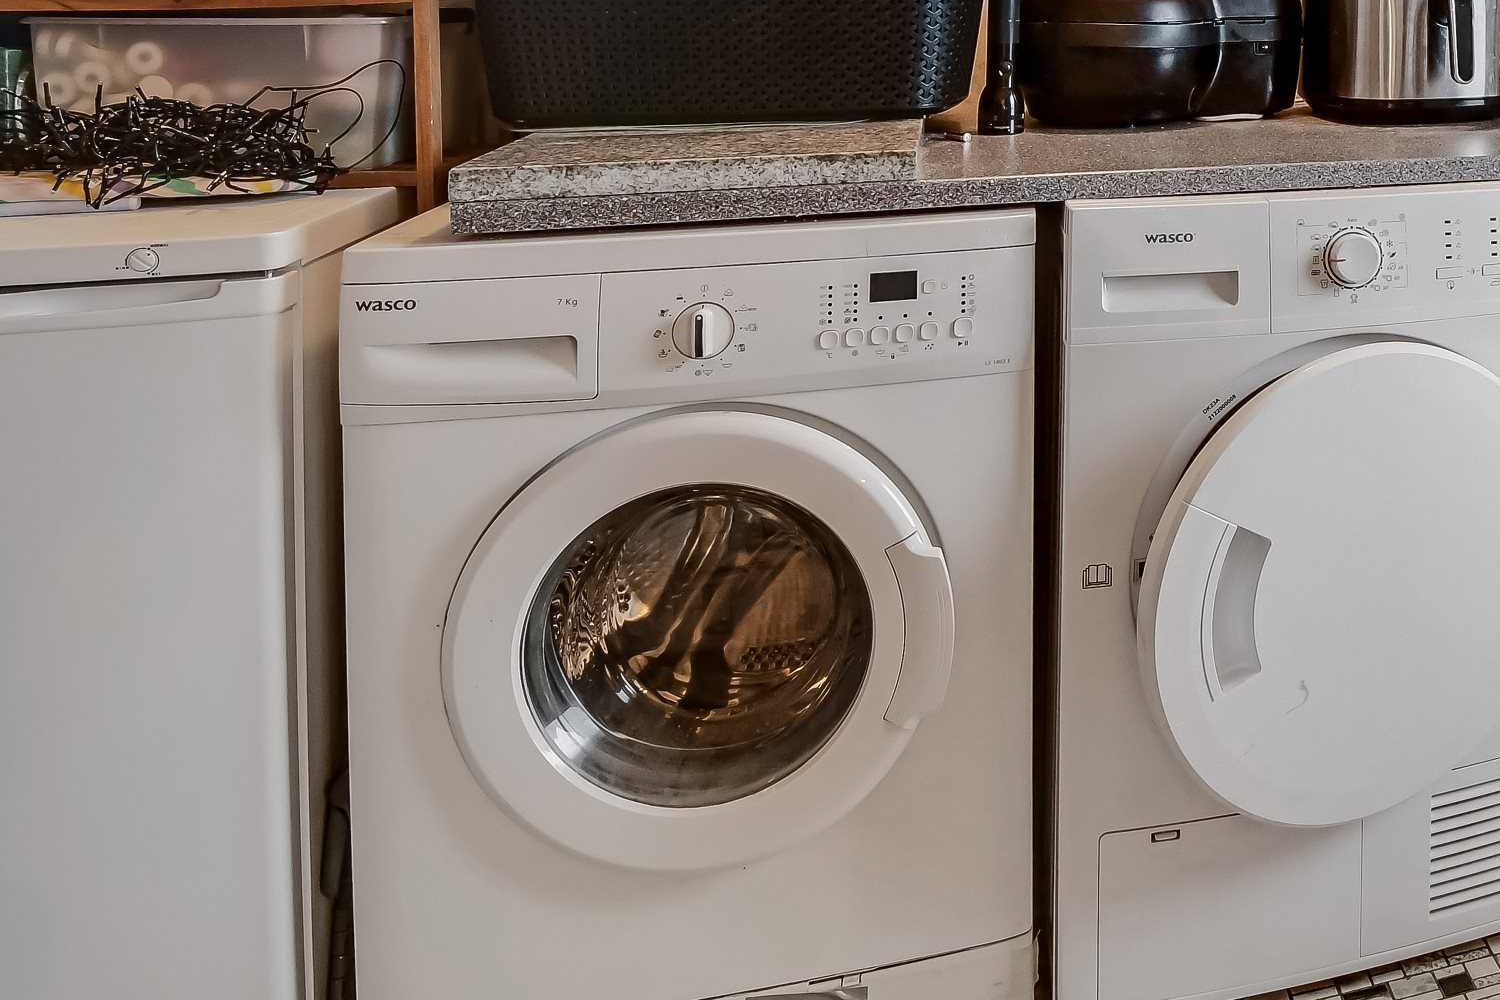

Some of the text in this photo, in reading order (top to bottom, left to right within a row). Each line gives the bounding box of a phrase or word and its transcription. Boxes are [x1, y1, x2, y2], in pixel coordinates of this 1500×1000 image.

[1145, 233, 1194, 244] wasco
[355, 299, 417, 312] wasco
[557, 298, 578, 308] 7 Kg
